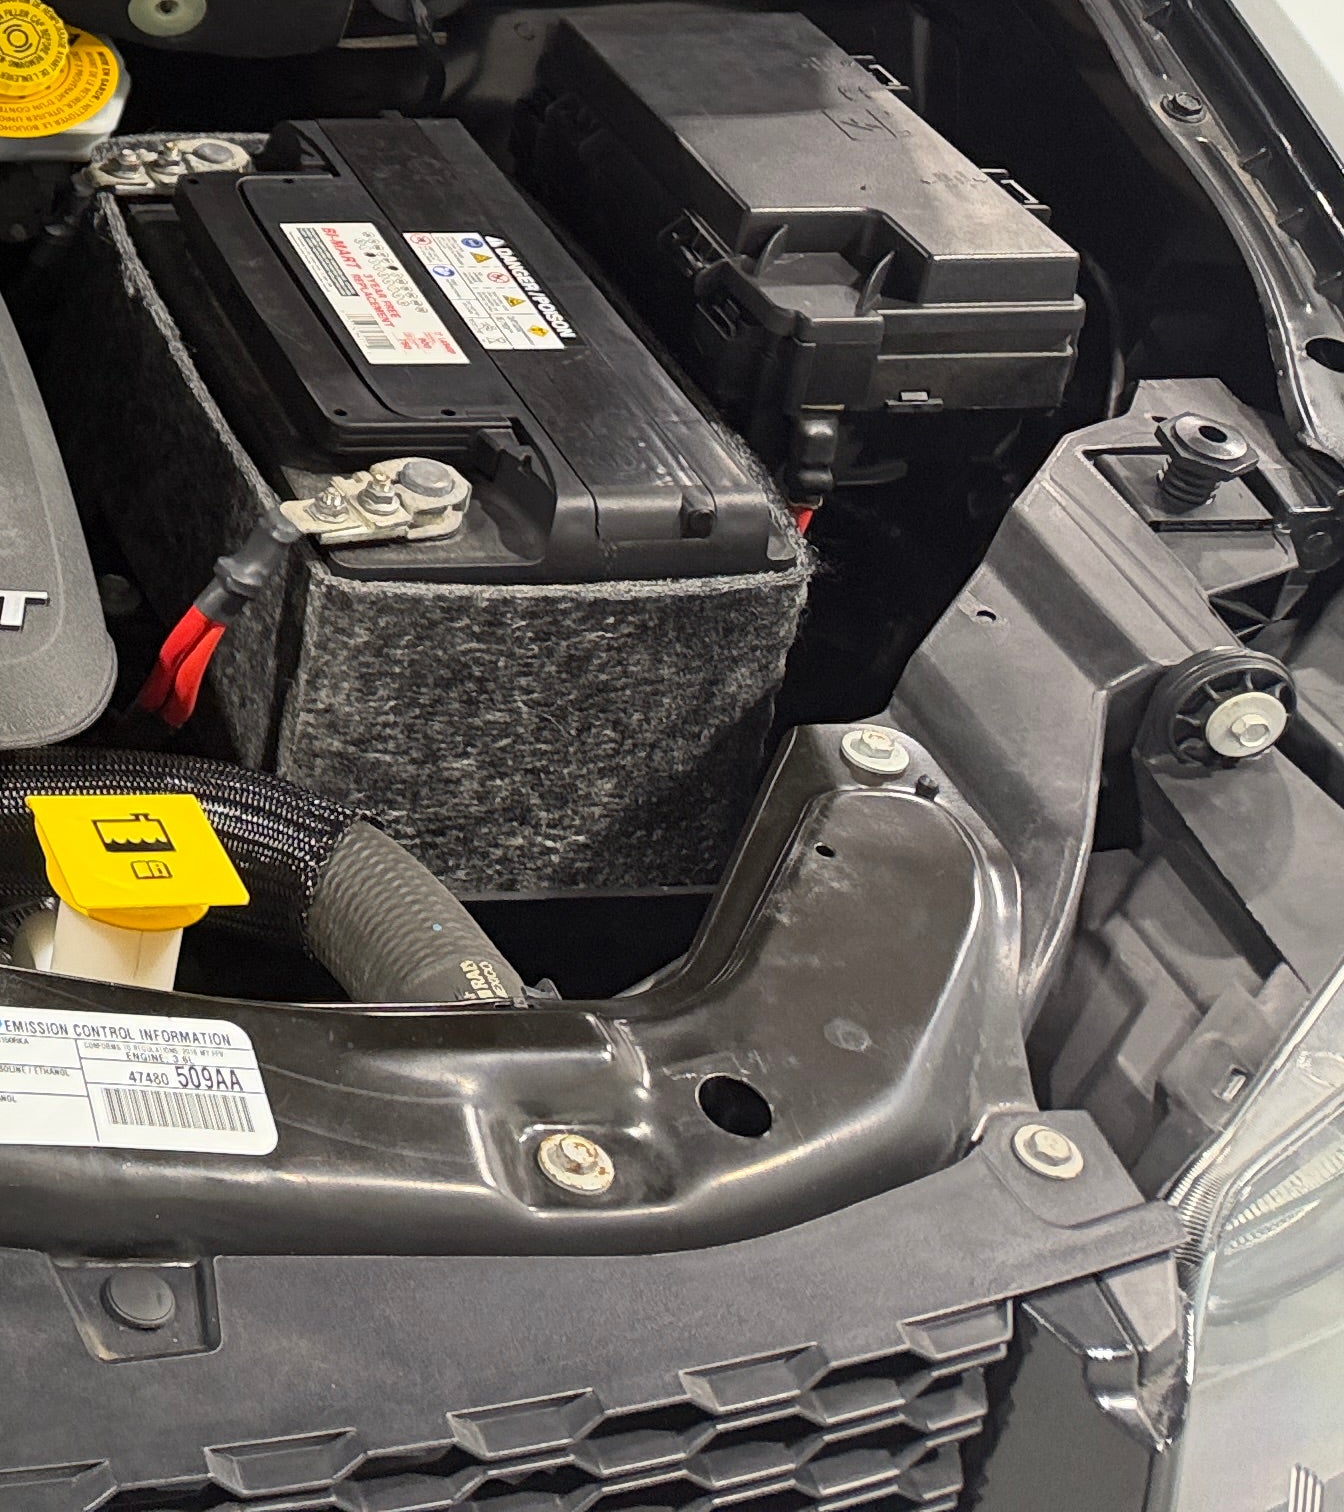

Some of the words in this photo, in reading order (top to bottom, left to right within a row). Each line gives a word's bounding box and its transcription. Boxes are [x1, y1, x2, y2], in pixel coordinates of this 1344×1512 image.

[5, 1019, 69, 1037] EMISSION
[73, 1023, 136, 1041] CONTROL
[139, 1028, 232, 1047] INFORMATION
[128, 1070, 170, 1086] 47480
[174, 1065, 245, 1092] 509AA
